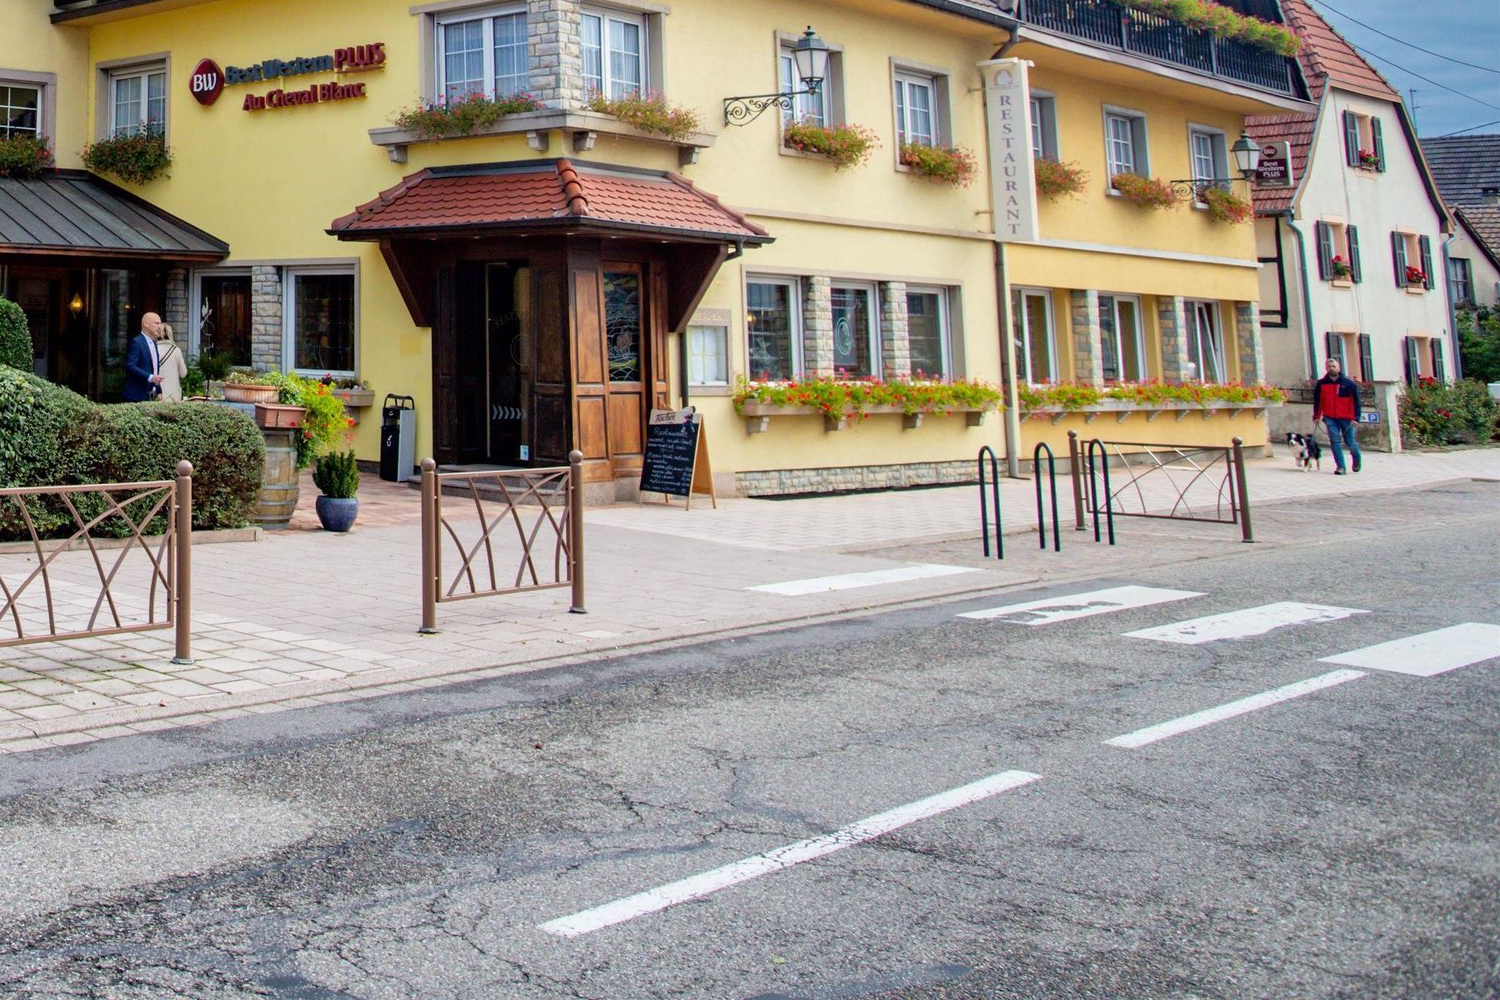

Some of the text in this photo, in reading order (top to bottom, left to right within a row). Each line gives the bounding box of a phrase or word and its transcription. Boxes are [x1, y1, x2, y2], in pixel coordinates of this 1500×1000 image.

[225, 42, 386, 85] Best Western PLUS
[193, 72, 217, 92] BW
[242, 81, 367, 111] Au Cheval Blanc
[999, 95, 1021, 235] RESTAURANT
